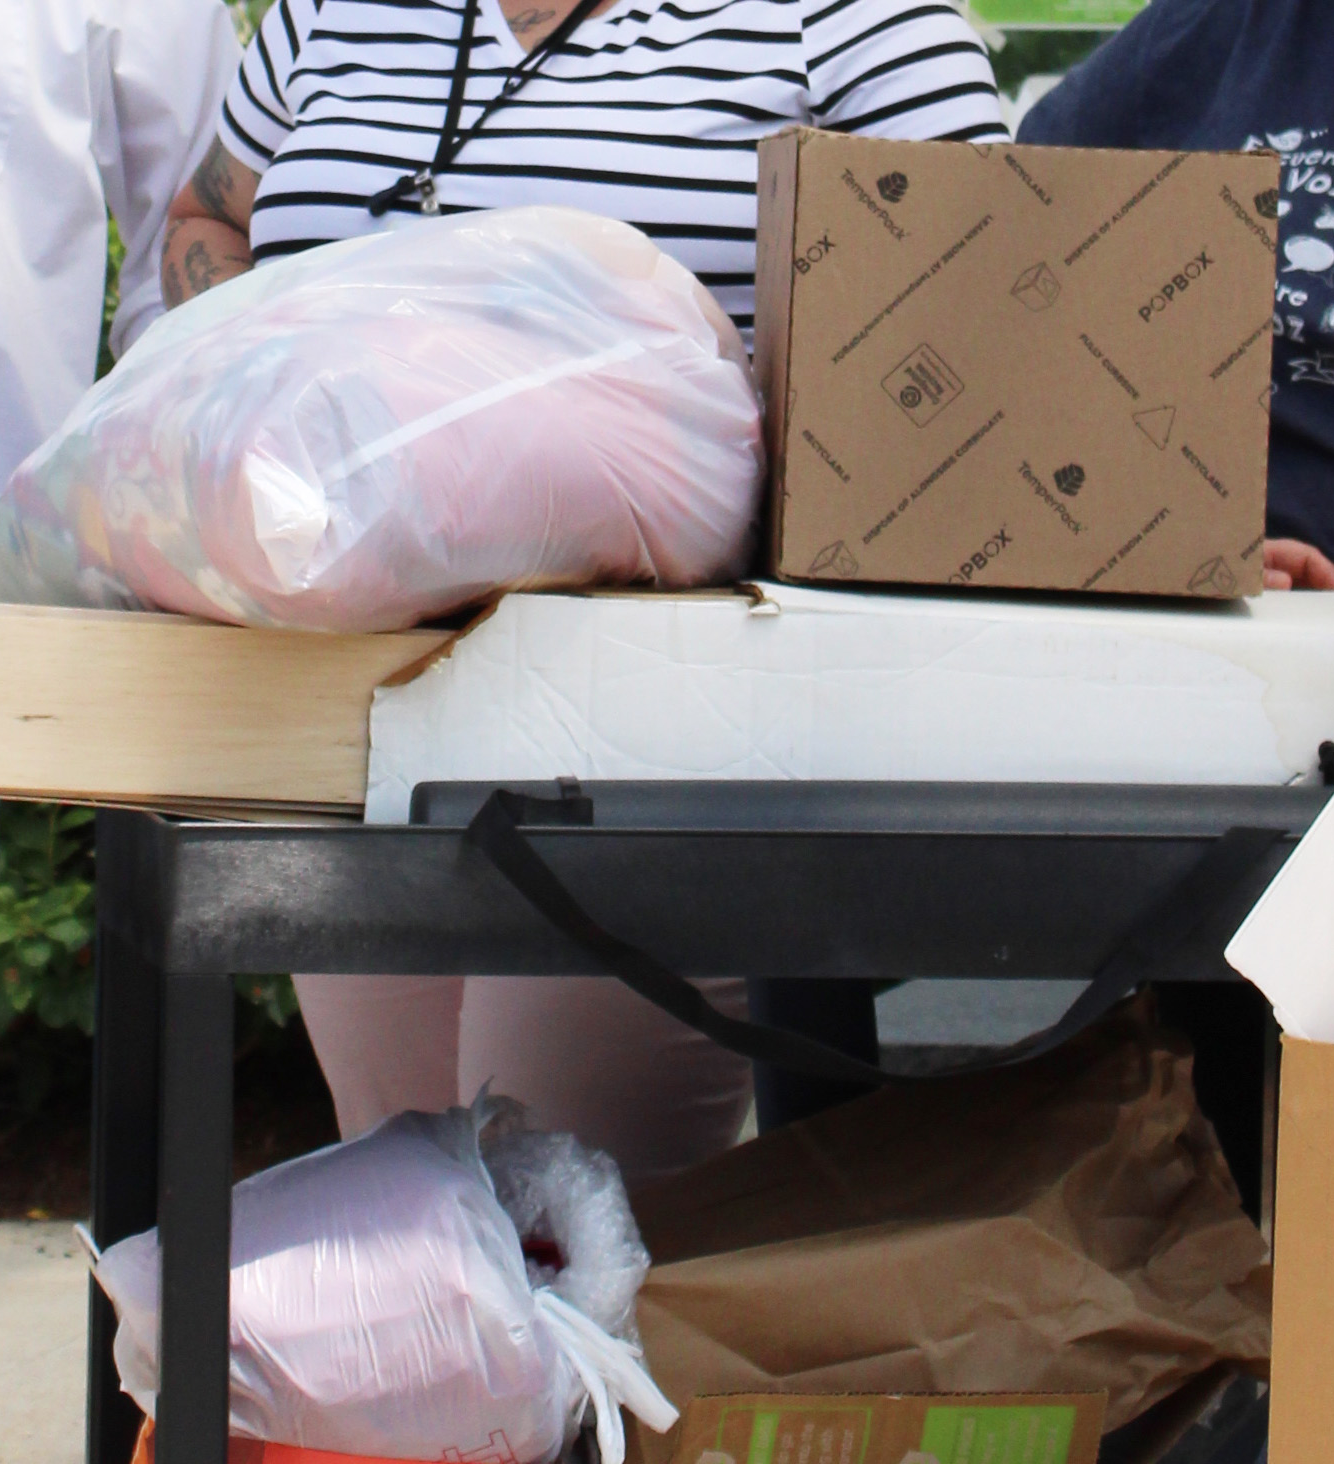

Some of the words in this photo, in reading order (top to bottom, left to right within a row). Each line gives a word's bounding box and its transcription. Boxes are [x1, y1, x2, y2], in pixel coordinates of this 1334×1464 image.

[841, 168, 907, 241] TemperPack
[1005, 154, 1053, 206] RECYCLABLE
[1064, 233, 1099, 266] DISPOSE
[1099, 222, 1110, 234] OF
[1111, 179, 1157, 223] ALONGSIDE
[1219, 185, 1276, 254] TemperPac
[794, 235, 836, 275] BOX
[1139, 252, 1214, 322] POPBOX
[1079, 333, 1103, 359] FULLY
[1101, 358, 1140, 400] CURBSIDE
[802, 430, 851, 483] RECYCLABLE
[863, 510, 898, 544] DISPOSE
[897, 498, 909, 512] OF
[910, 456, 956, 502] ALONGSIDE
[955, 410, 1005, 457] CORRUGATE
[1181, 445, 1229, 498] RECYCLABLE
[1018, 461, 1081, 536] TemperPack
[948, 529, 1012, 583] OPBOX
